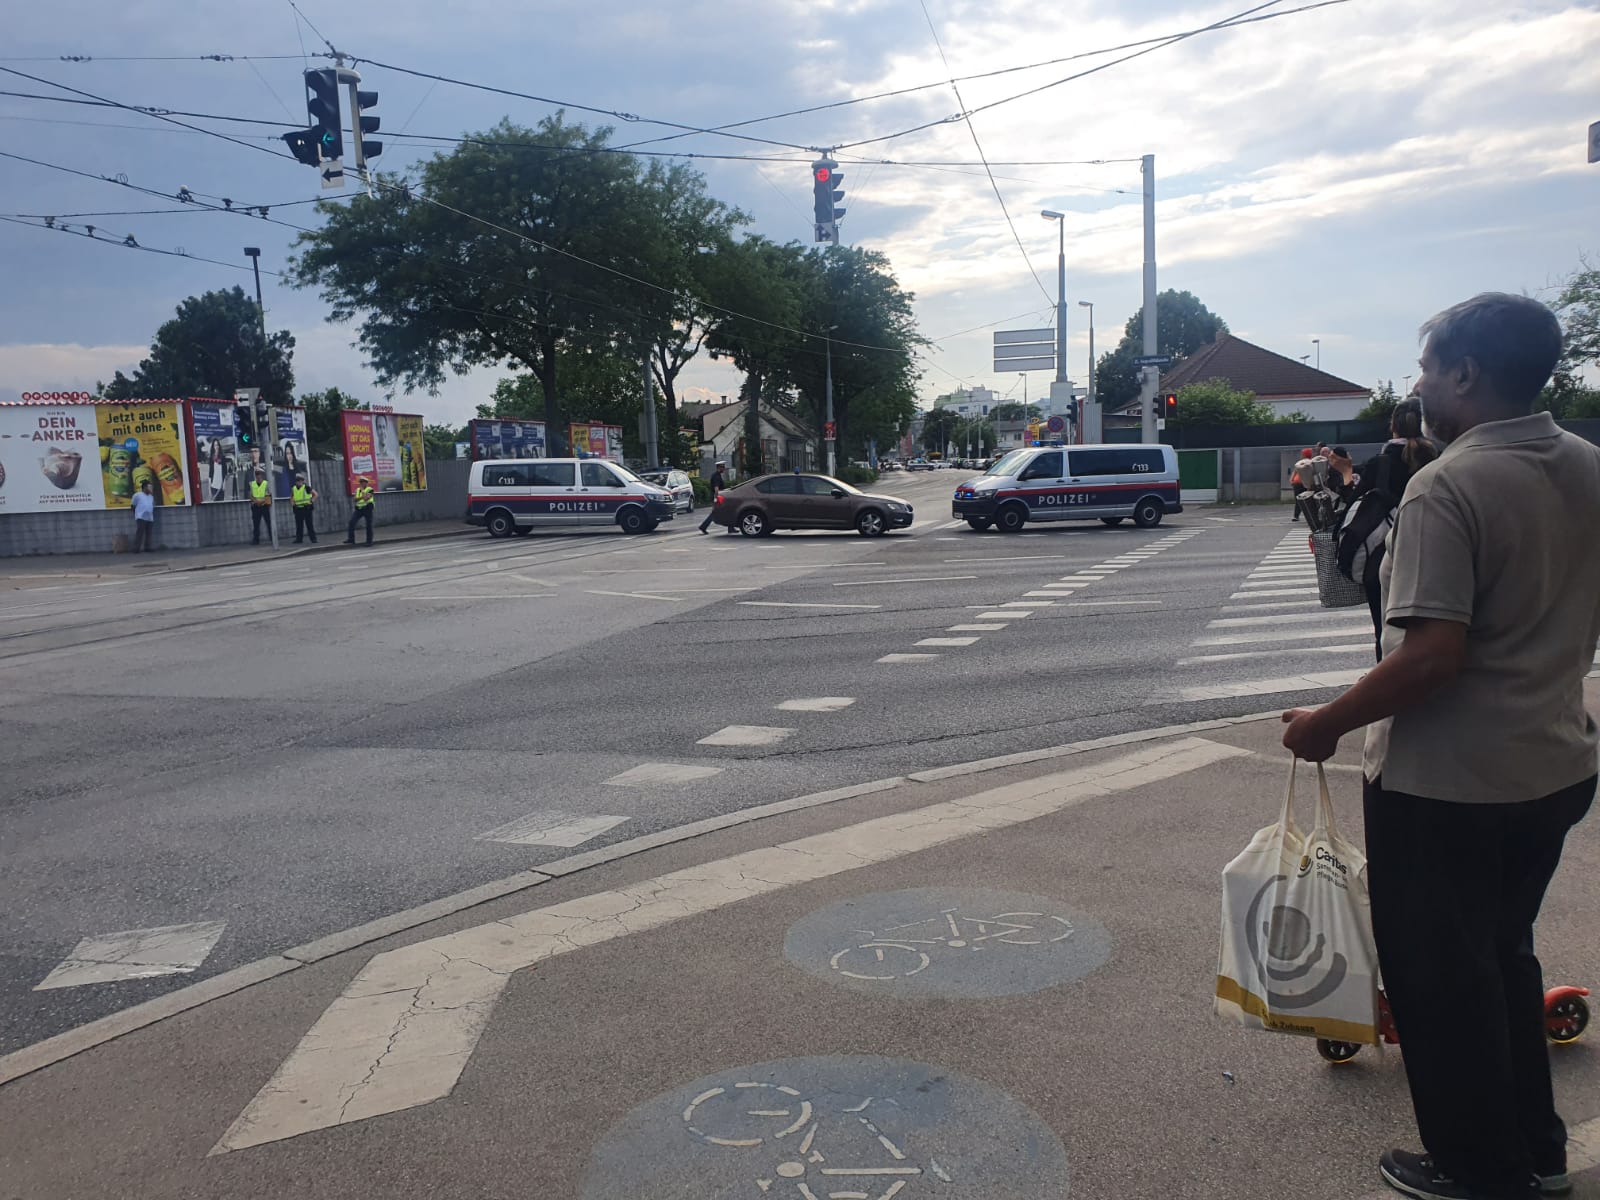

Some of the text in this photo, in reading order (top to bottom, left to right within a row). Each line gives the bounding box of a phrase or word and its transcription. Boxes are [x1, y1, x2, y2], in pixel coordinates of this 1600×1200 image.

[106, 408, 165, 424] Jetzt auch
[38, 417, 76, 428] DEIN
[112, 422, 166, 436] mit ohne.
[32, 430, 85, 441] ANKER
[1136, 463, 1149, 472] 133
[1038, 493, 1089, 505] POLIZEI
[549, 502, 598, 512] POLIZEI
